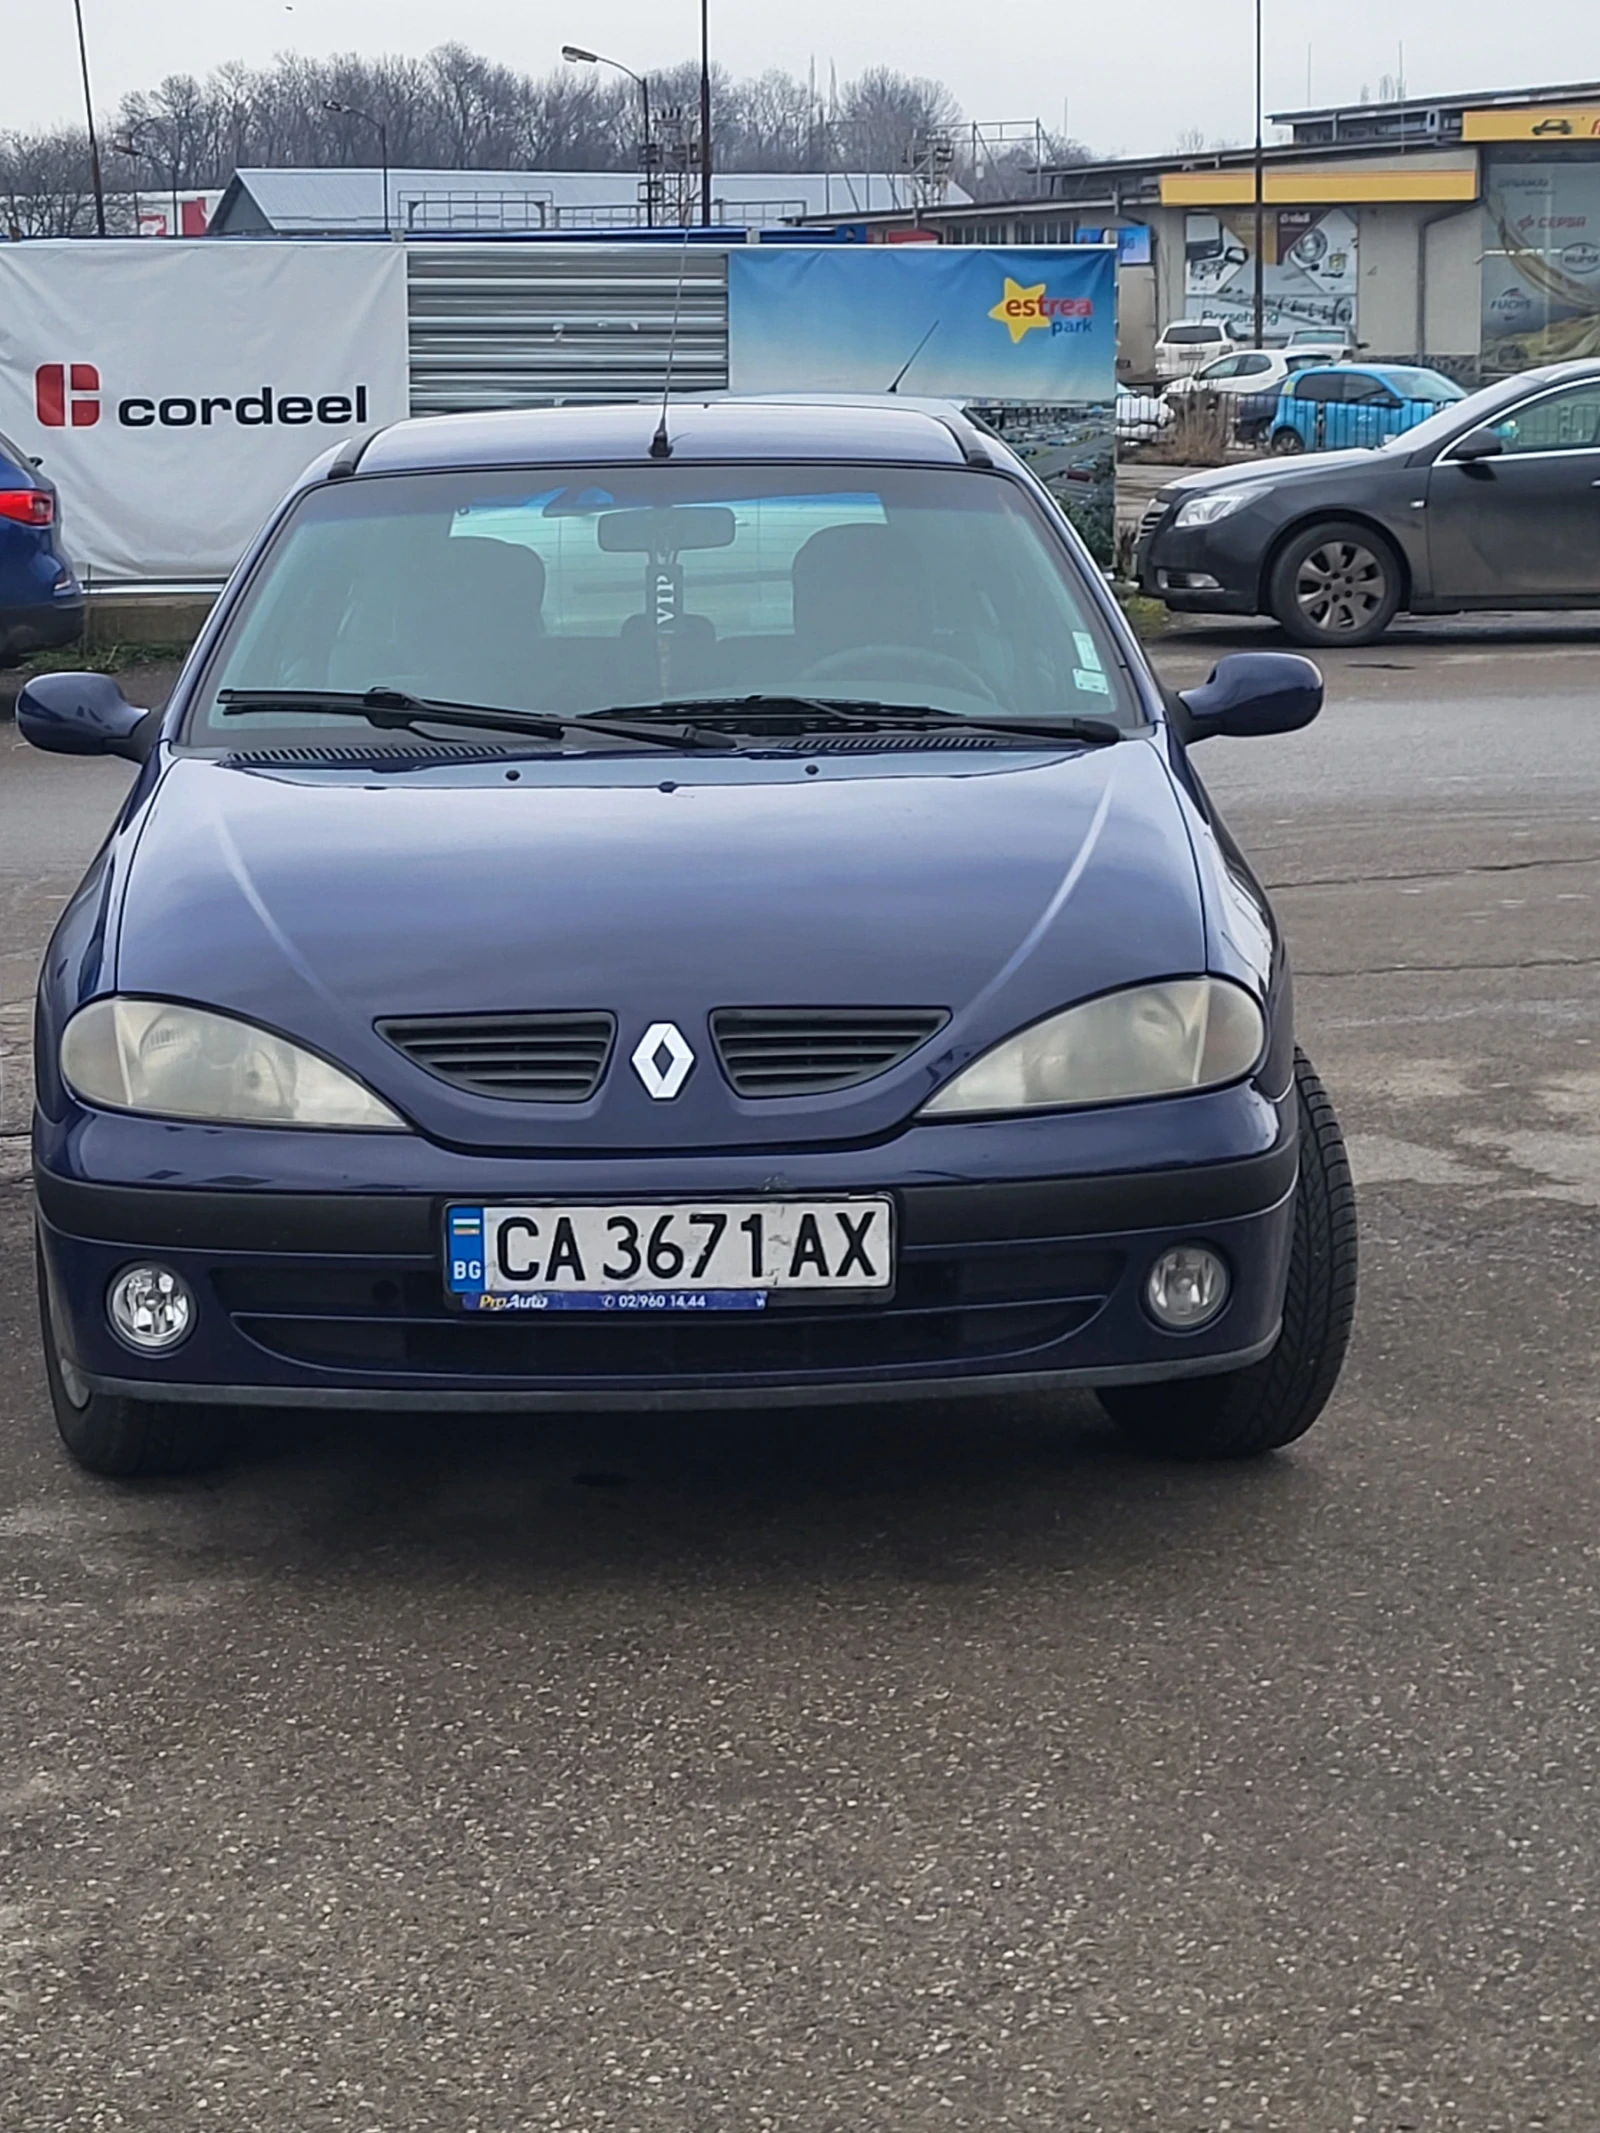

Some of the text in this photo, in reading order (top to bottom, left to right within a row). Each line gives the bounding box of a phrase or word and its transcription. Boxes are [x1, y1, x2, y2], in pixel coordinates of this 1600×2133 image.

[1005, 295, 1093, 317] estrea
[1051, 317, 1093, 336] park
[119, 386, 367, 426] cordeel
[656, 575, 675, 625] VIP
[497, 1210, 877, 1281] CA 3671 AX
[453, 1260, 482, 1280] BG
